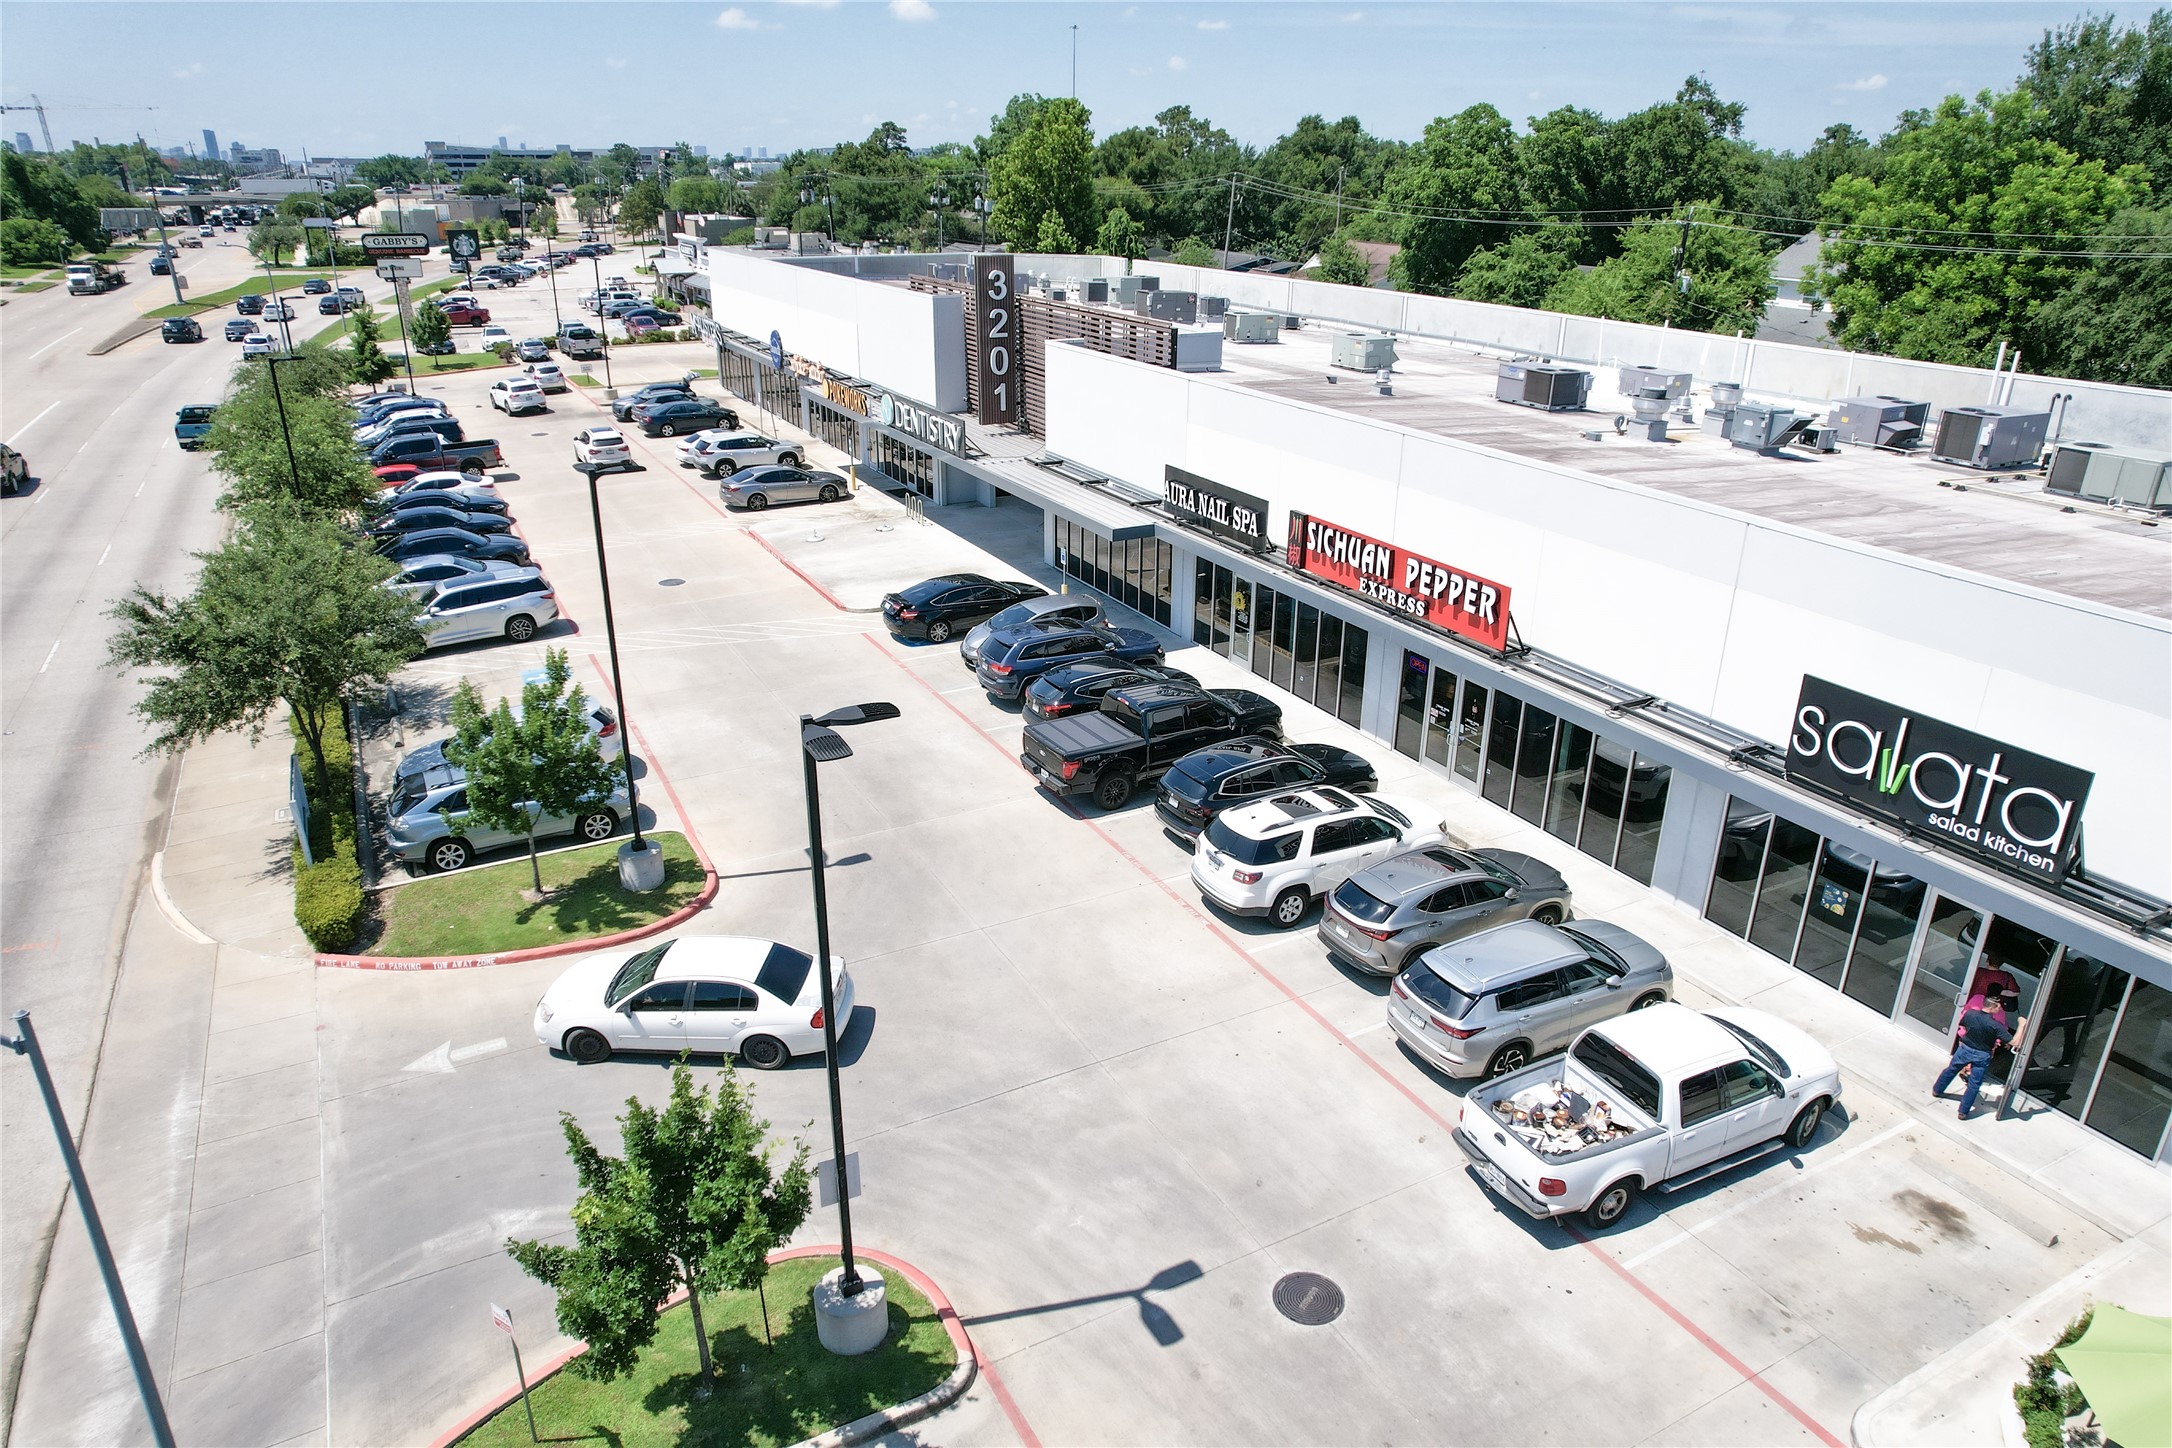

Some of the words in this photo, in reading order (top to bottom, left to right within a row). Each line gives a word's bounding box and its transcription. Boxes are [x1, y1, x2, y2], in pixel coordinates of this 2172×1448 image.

[372, 238, 418, 246] GABBY'S
[987, 269, 1009, 412] 3201
[829, 381, 868, 416] POKEWORKS
[895, 402, 962, 451] DENTISTRY
[1163, 480, 1196, 513] AURA
[1198, 492, 1230, 526] NAIL
[1232, 505, 1259, 538] SPA
[1306, 521, 1391, 580] SICHUAN
[1405, 557, 1497, 625] PEPPER
[1358, 576, 1426, 617] EXPRESS
[1411, 657, 1425, 671] OPEN
[1792, 704, 2076, 855] salata
[1928, 811, 1981, 843] salad
[1983, 830, 2055, 874] kitchen
[320, 958, 337, 967] FIRE
[341, 960, 360, 969] LANE
[375, 961, 385, 970] NO
[389, 962, 422, 971] PARKING
[432, 961, 448, 970] TOW
[452, 959, 473, 968] AWAY
[476, 956, 497, 967] ZONE
